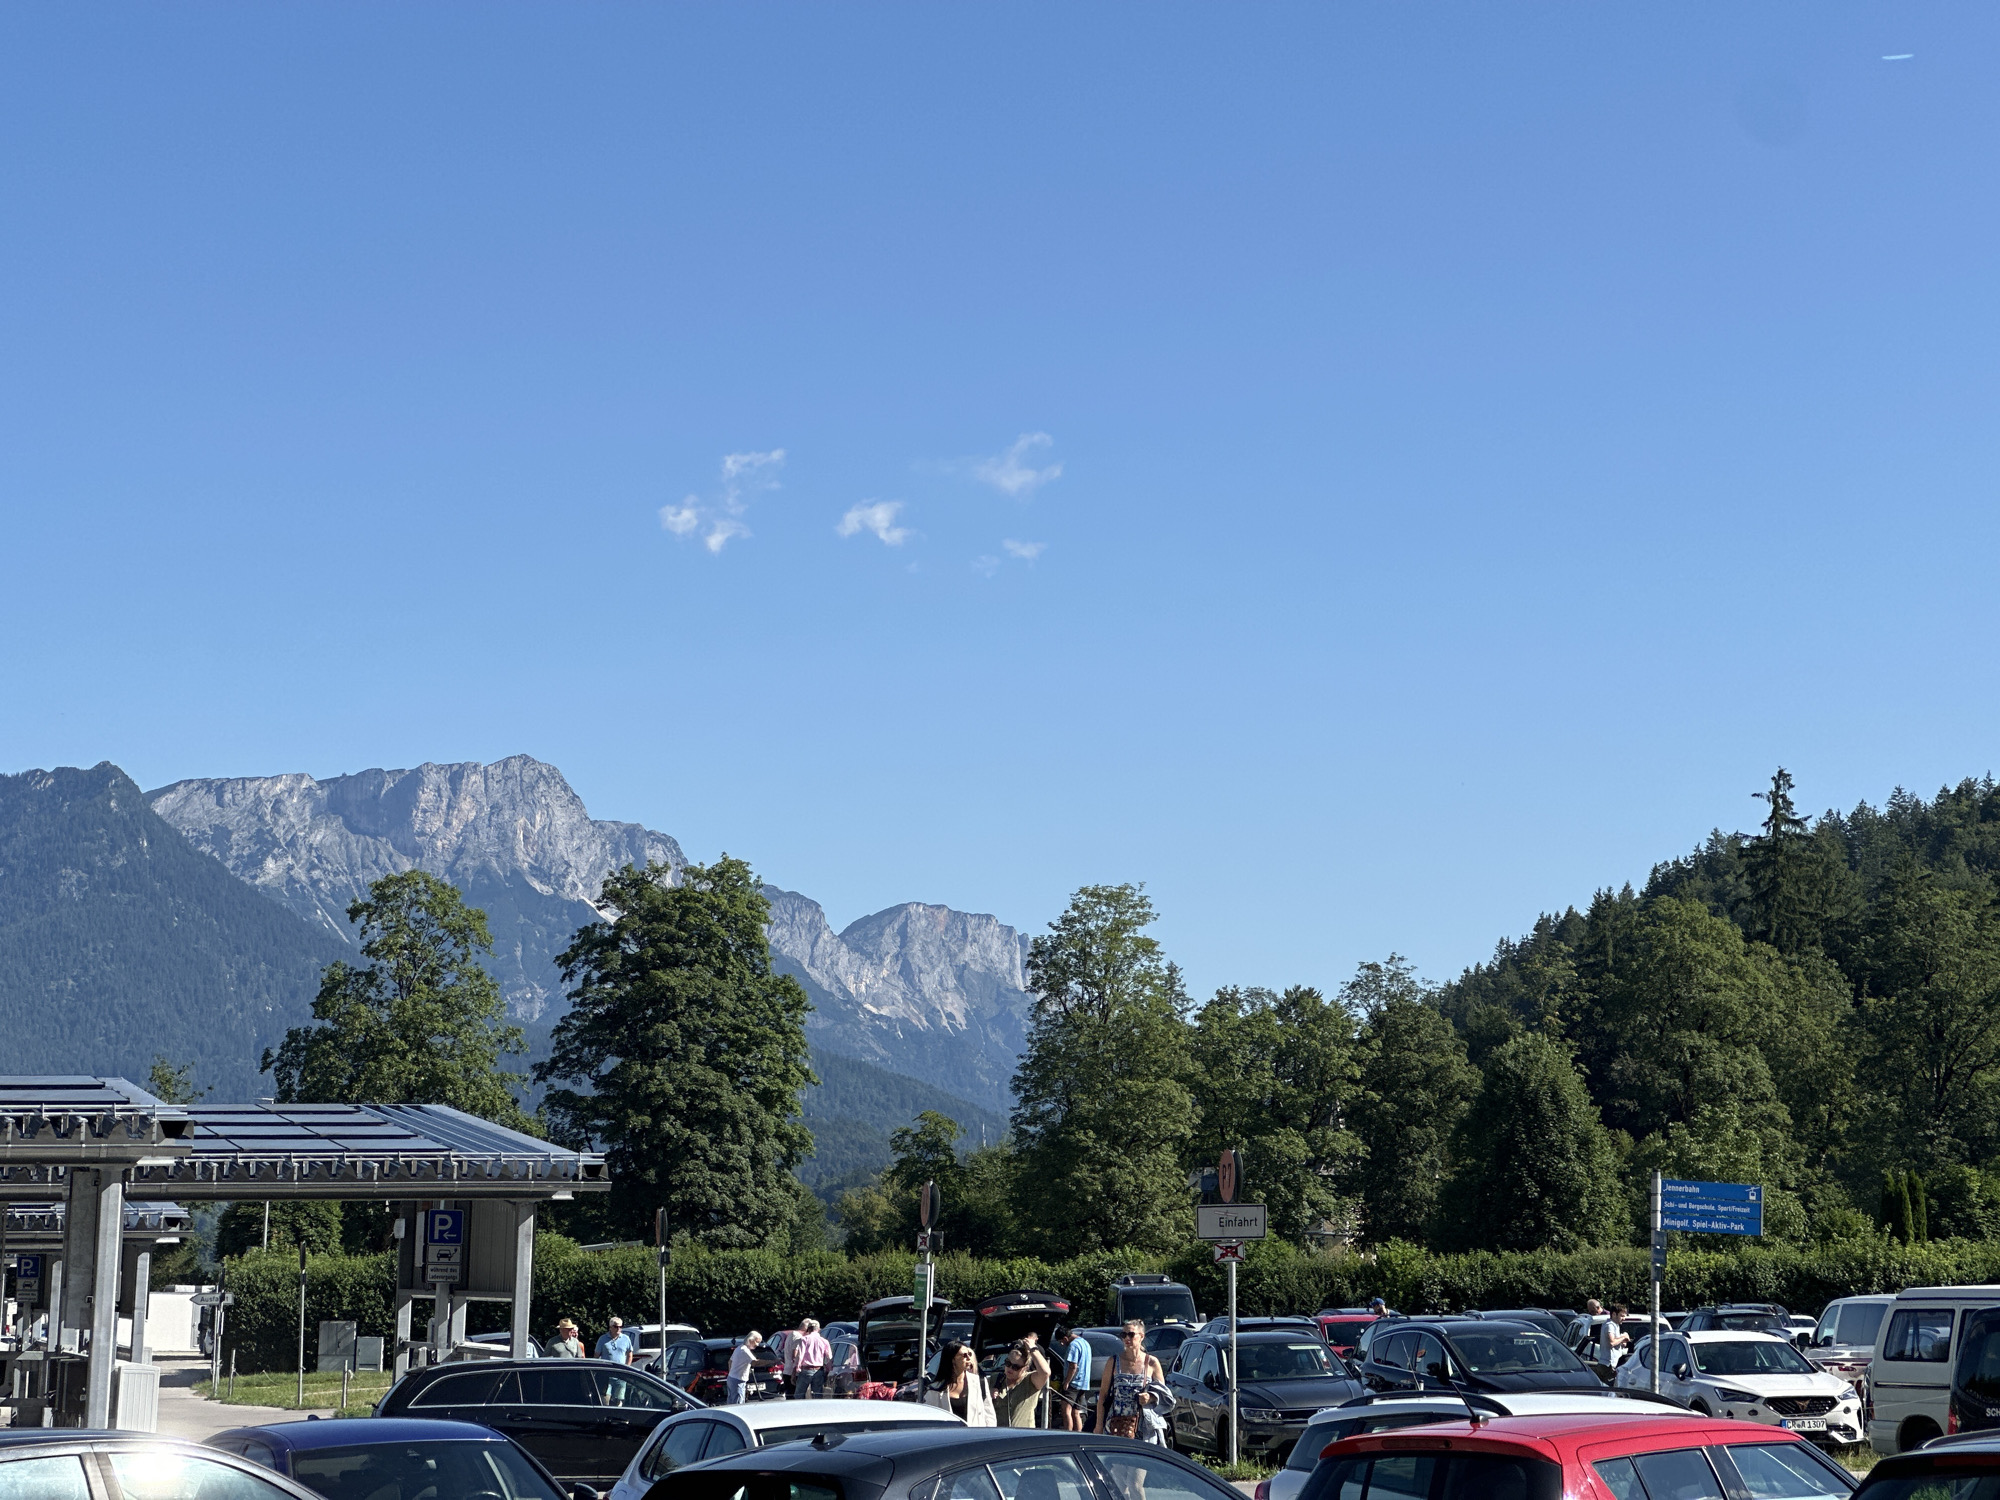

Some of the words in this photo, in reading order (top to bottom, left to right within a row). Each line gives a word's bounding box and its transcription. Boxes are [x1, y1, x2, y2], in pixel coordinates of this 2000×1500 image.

[1662, 1183, 1700, 1194] Jennerbahn
[1717, 1205, 1751, 1213] Sport/Freizeit
[434, 1214, 453, 1240] P
[1219, 1217, 1258, 1228] Einfahrt
[1692, 1220, 1745, 1231] Spiel-Aktiv-Park
[20, 1259, 33, 1276] P
[1807, 1420, 1825, 1429] 1307
